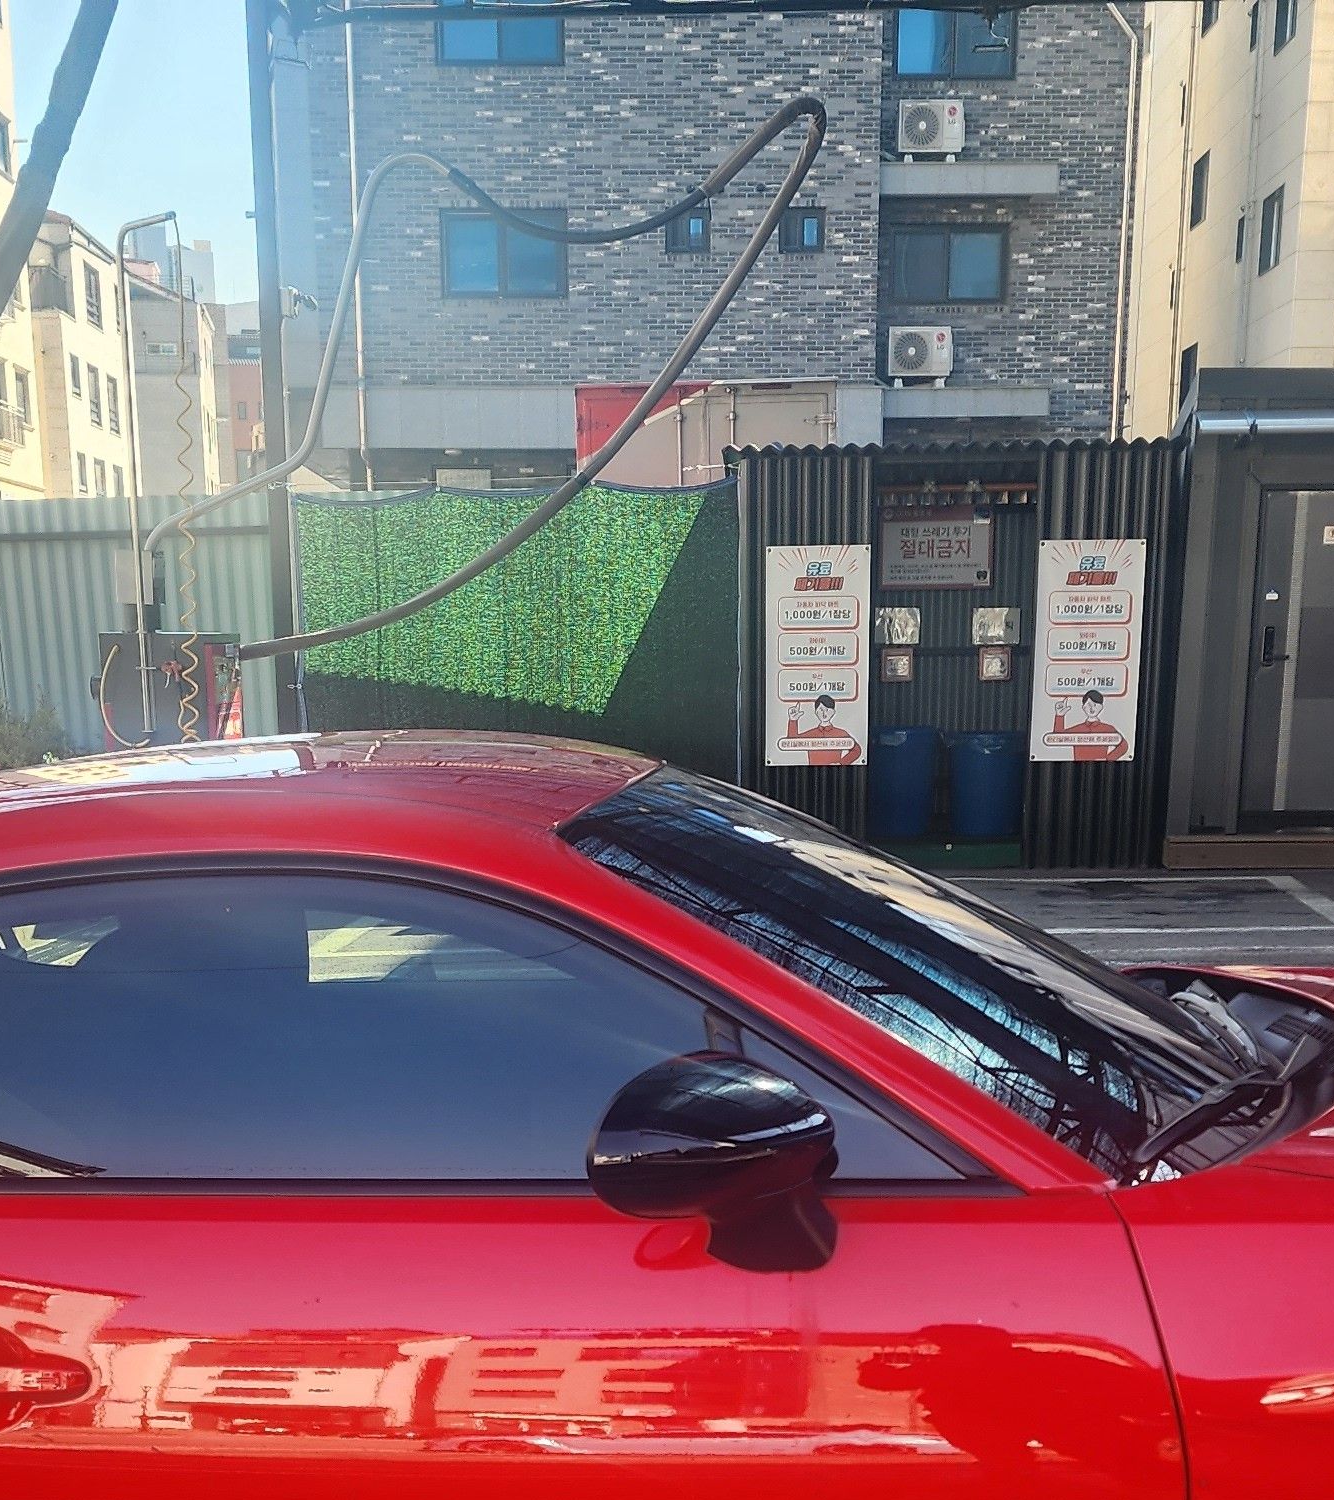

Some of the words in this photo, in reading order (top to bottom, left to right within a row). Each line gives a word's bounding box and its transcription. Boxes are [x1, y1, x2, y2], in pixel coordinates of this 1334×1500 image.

[922, 526, 950, 537] 쓰레기
[952, 526, 971, 537] 투기
[900, 538, 972, 559] 절대금지
[1079, 556, 1106, 570] 유료
[806, 562, 832, 576] 유료
[1056, 603, 1123, 614] 1,000원/1장당
[785, 609, 851, 620] 1,000원/1장당
[789, 645, 846, 656] 500원/1개당
[1059, 640, 1116, 650] 500원/1개당
[789, 681, 845, 692] 500원/1개당
[1057, 677, 1114, 687] 500원/1개당
